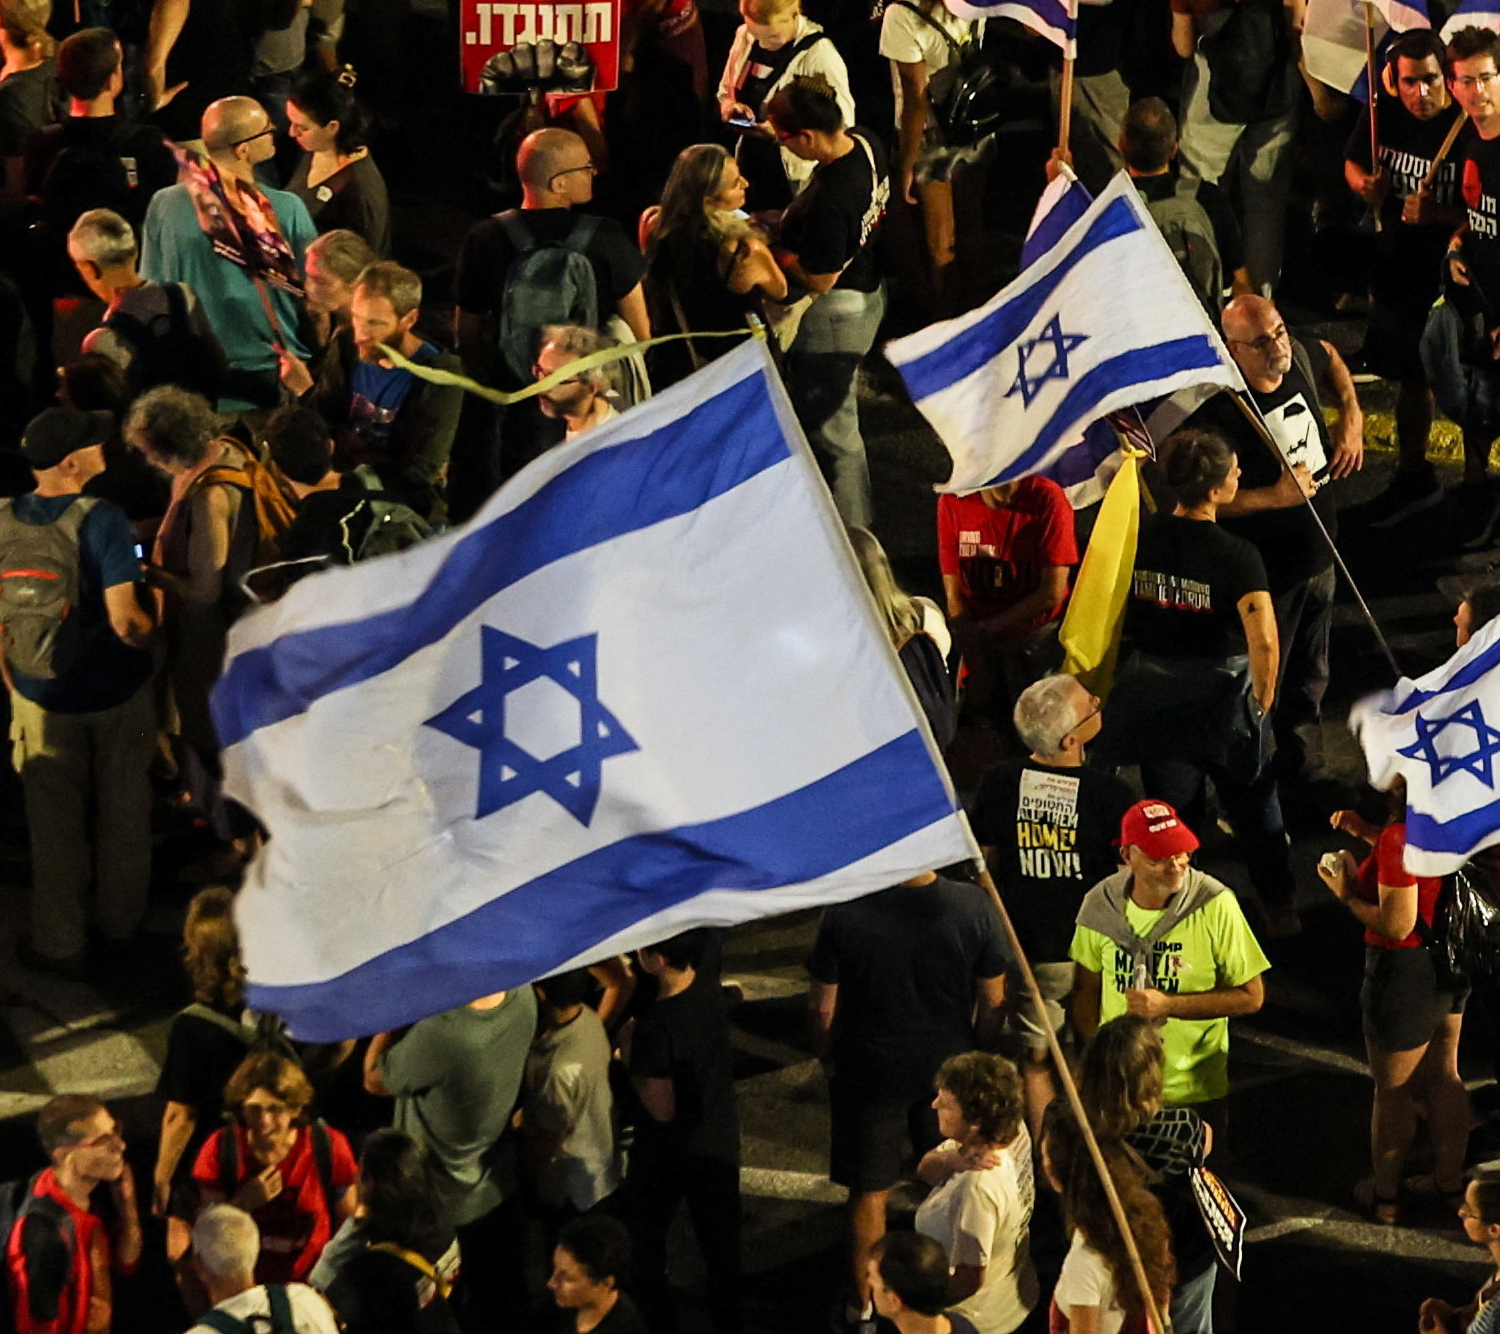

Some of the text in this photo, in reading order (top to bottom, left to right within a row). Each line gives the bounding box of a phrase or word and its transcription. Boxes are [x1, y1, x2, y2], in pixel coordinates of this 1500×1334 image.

[465, 2, 612, 47] תתנגדו.
[1017, 821, 1077, 851] HOME!
[1019, 848, 1083, 880] NOW!
